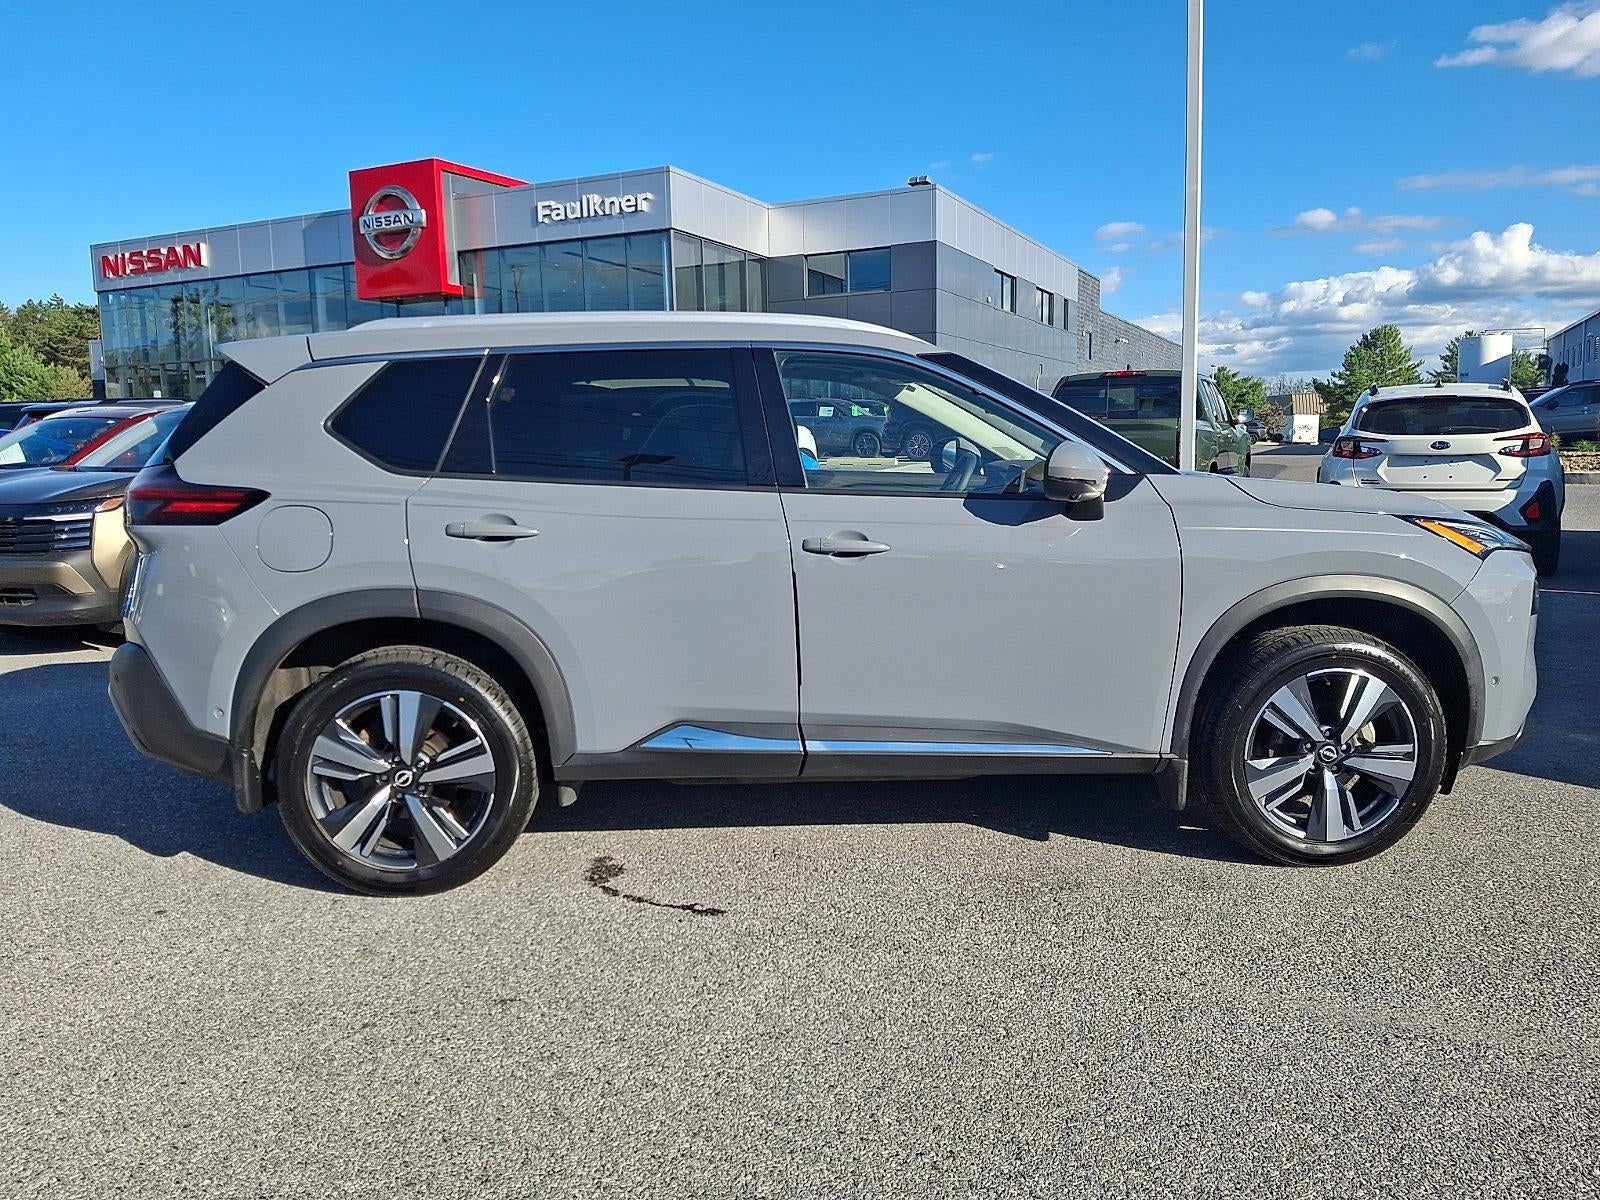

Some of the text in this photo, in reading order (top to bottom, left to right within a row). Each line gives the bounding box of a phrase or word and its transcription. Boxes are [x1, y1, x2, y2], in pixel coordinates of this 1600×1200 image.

[363, 212, 414, 230] NISSAN
[537, 192, 653, 223] Faulkner
[101, 243, 205, 278] NISSAN
